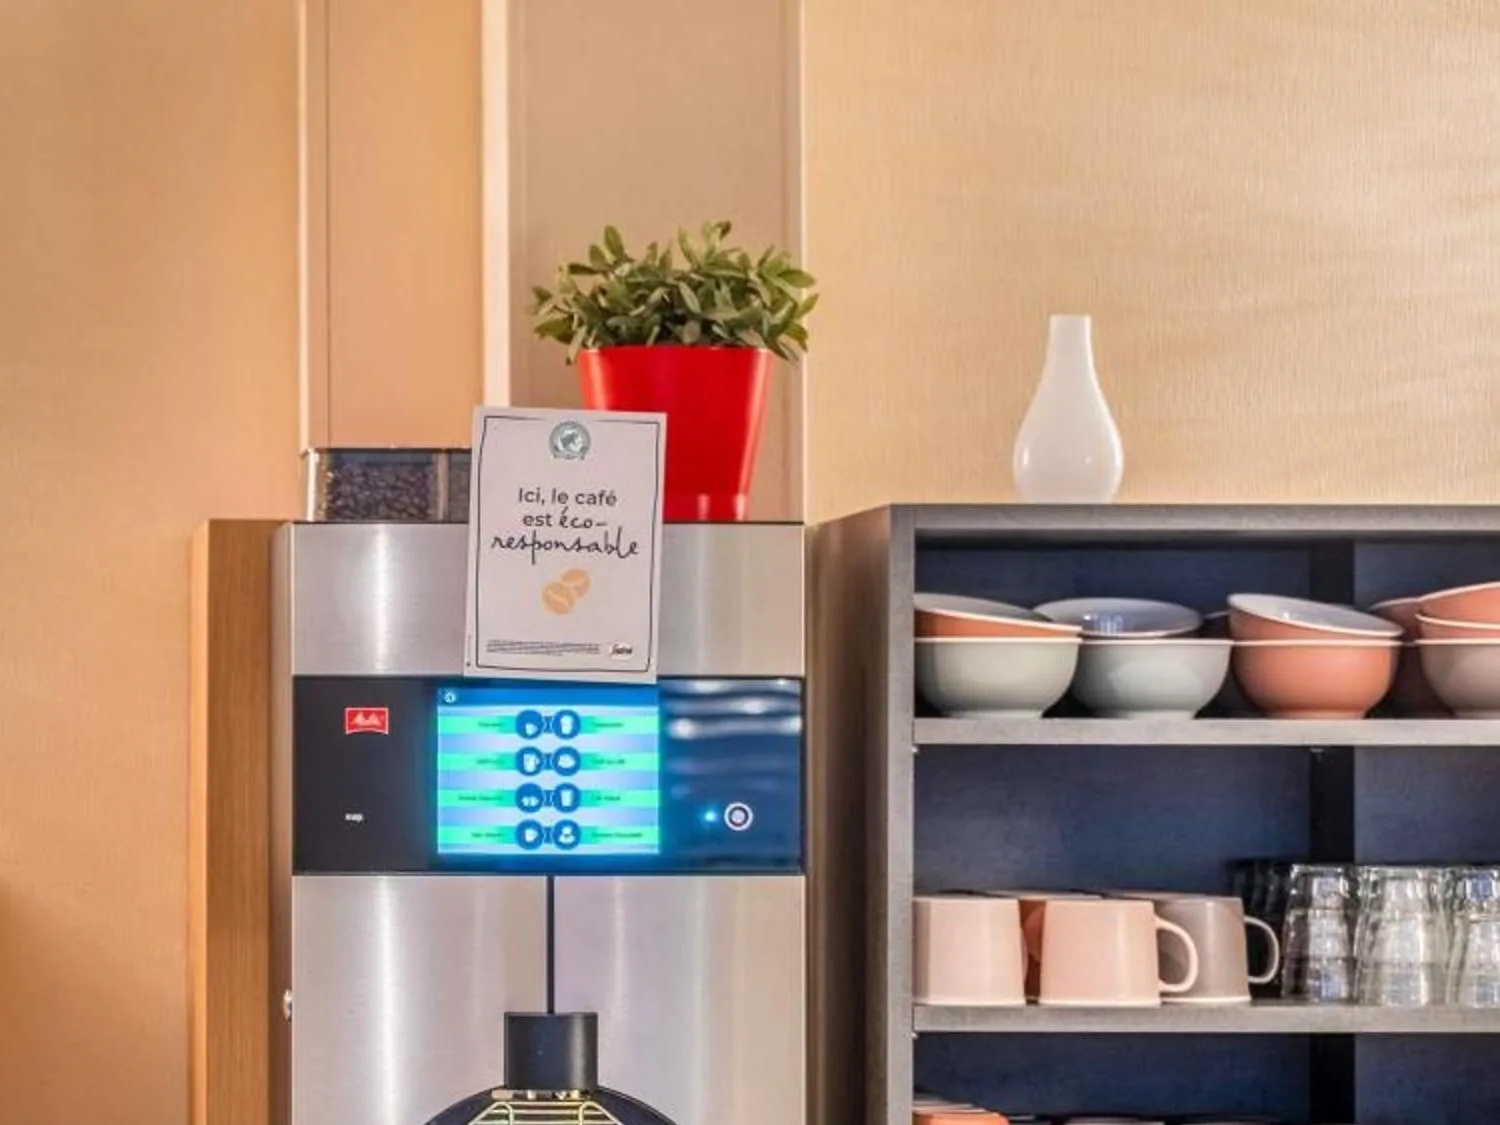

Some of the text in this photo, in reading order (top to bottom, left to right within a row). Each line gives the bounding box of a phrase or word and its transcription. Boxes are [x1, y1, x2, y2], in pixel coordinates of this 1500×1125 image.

[518, 487, 617, 507] Ici, le café
[522, 506, 607, 529] est éco-
[491, 526, 639, 566] responsable
